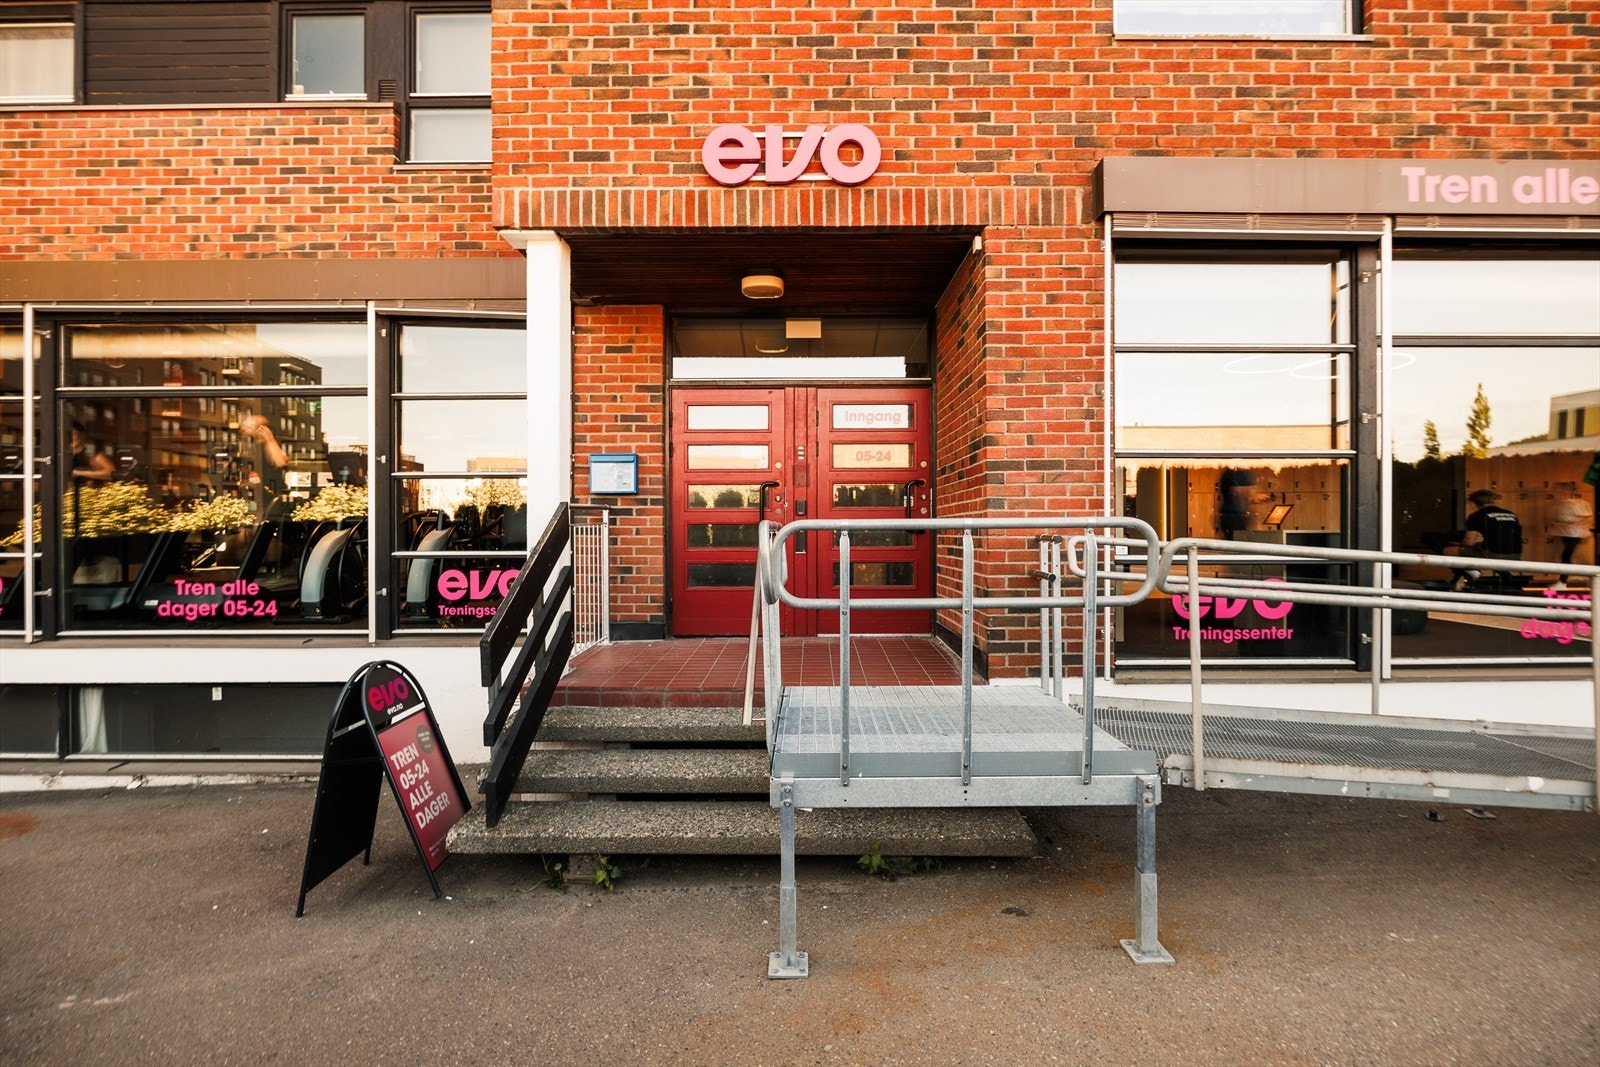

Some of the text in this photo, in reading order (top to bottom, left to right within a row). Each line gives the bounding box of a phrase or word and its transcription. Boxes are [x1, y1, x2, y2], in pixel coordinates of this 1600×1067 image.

[702, 124, 882, 186] evo
[1401, 167, 1600, 204] Tren alle
[845, 410, 901, 424] Inngang
[856, 451, 892, 461] 05-24
[174, 580, 259, 595] Tren alle
[158, 600, 277, 620] dager 05-24
[438, 605, 497, 618] Treningss
[1521, 618, 1592, 645] dage
[368, 677, 409, 711] evo
[387, 703, 403, 715] evo.no
[390, 743, 420, 770] TREN
[400, 759, 430, 790] 05-24
[409, 780, 434, 810] ALLE
[415, 791, 451, 829] DAGER
